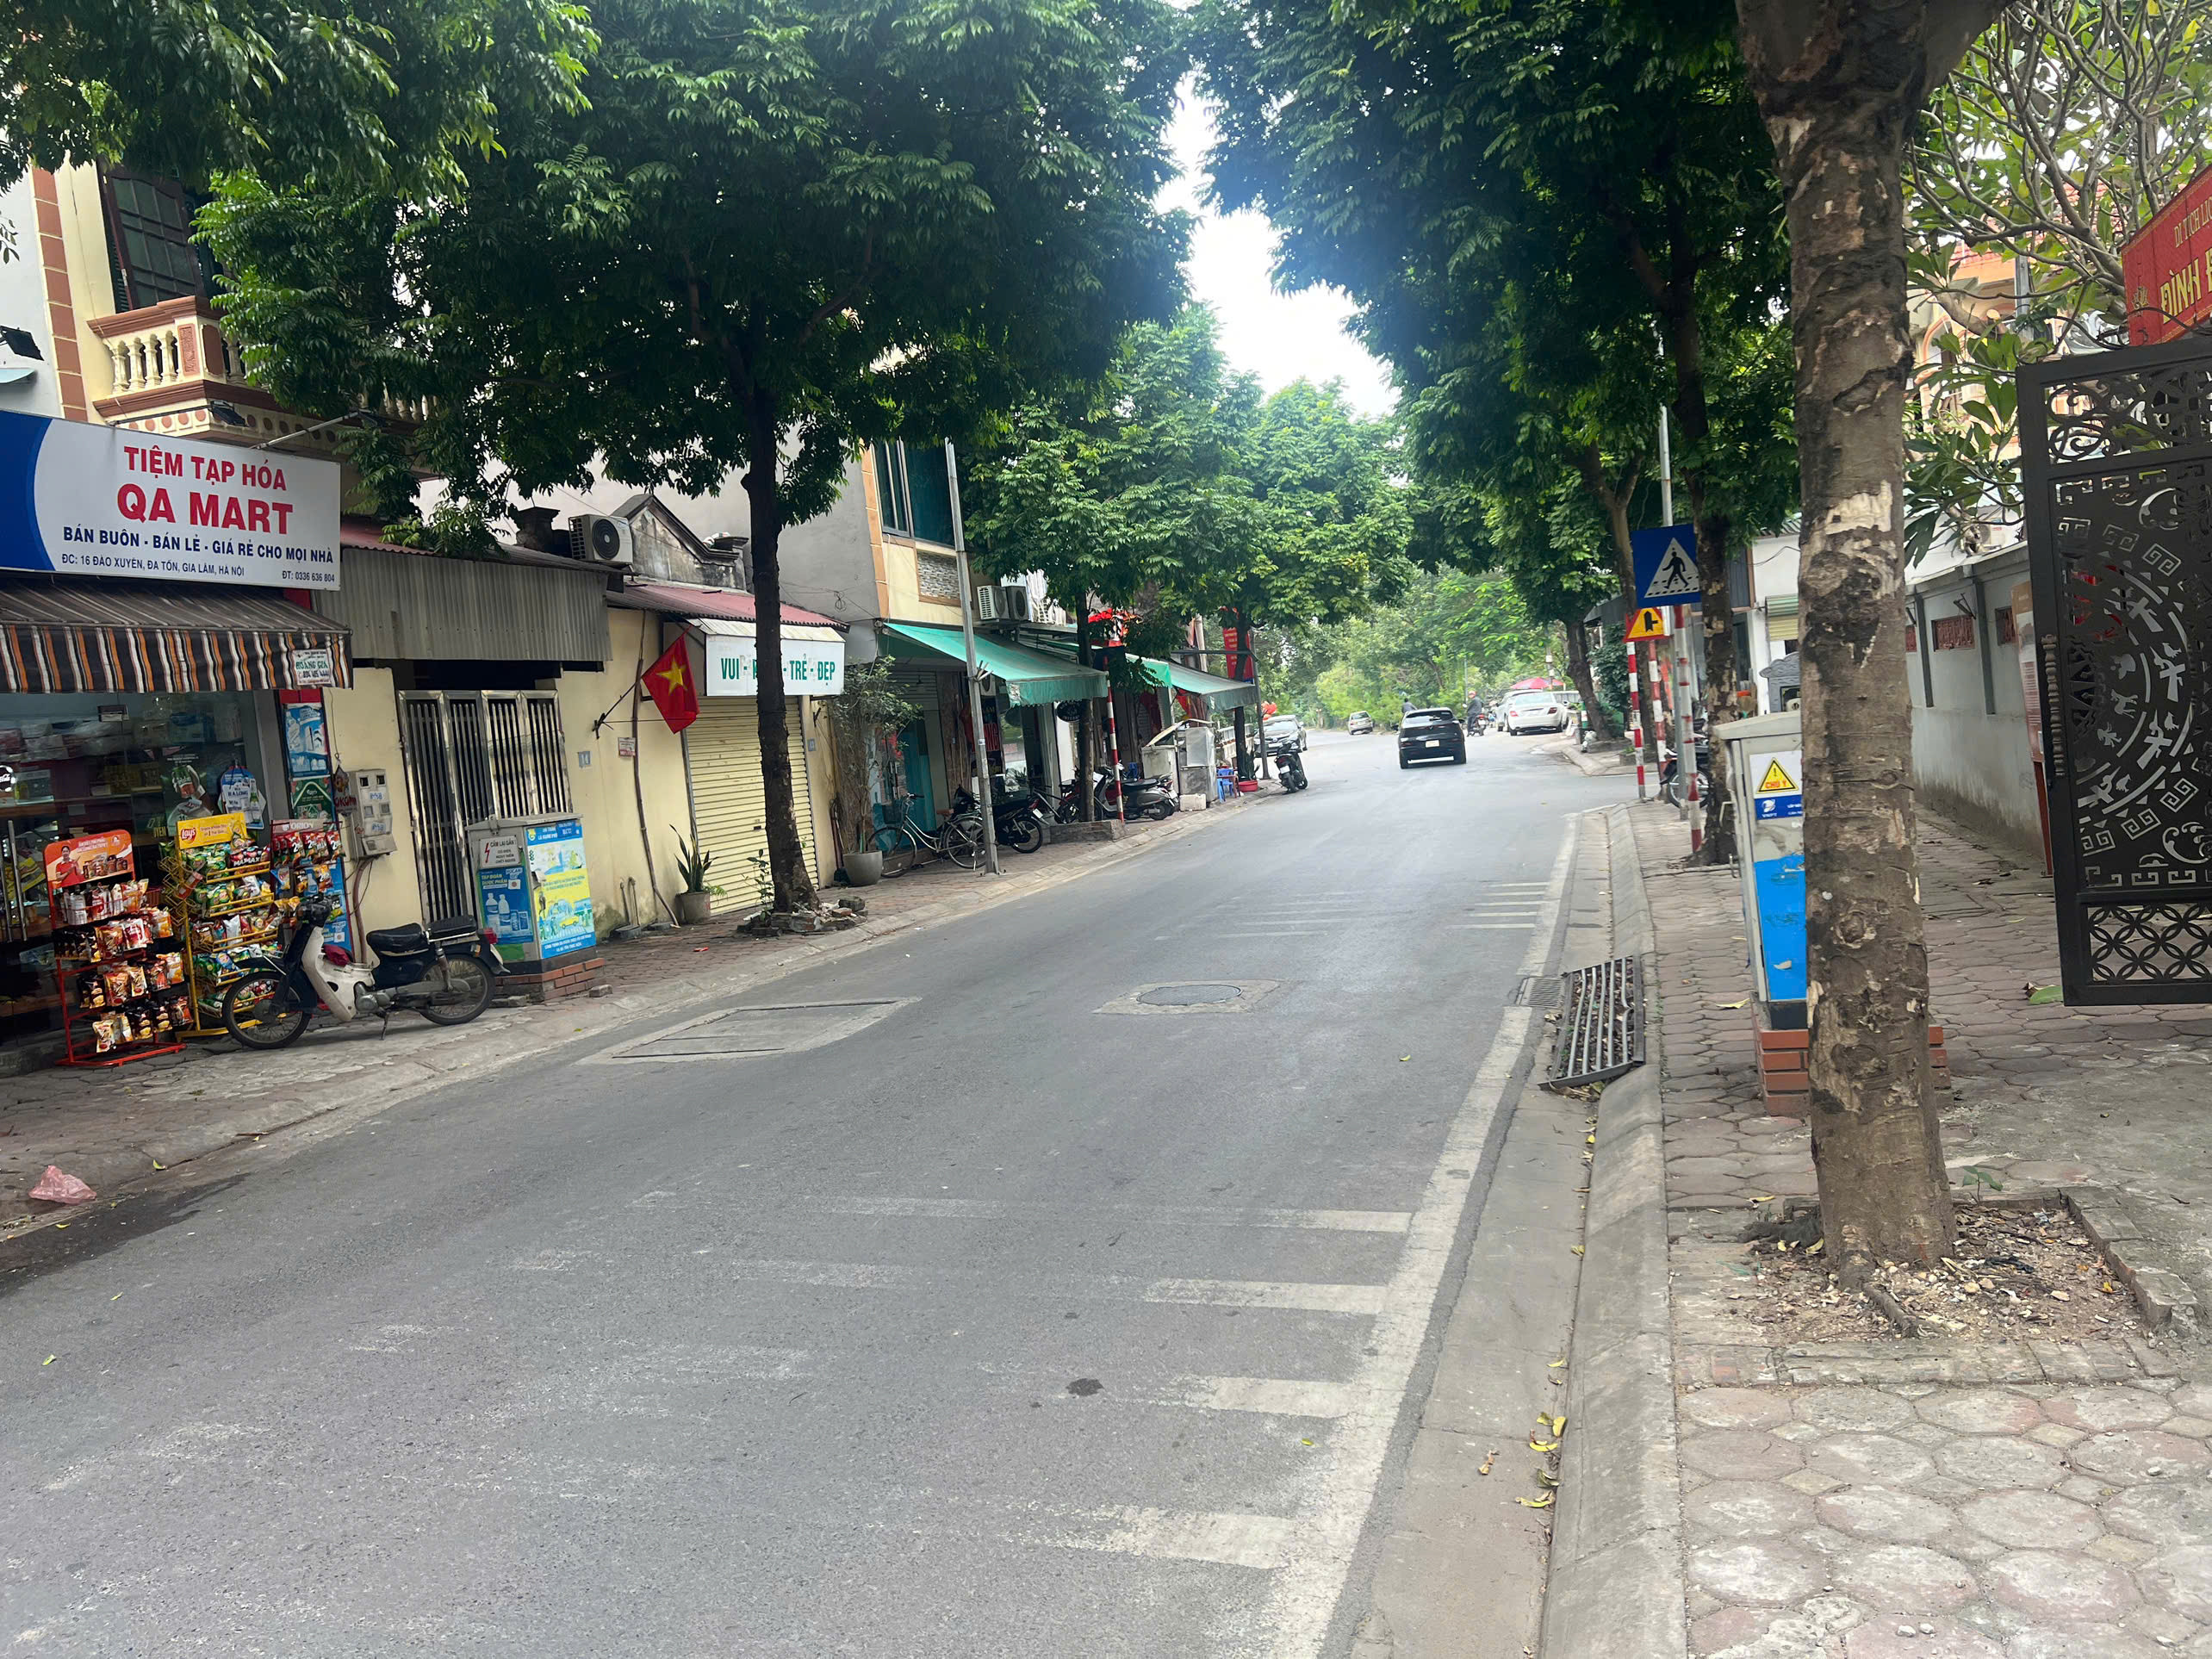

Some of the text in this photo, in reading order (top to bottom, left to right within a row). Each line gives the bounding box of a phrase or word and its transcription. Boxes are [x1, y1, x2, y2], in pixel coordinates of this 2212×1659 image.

[2159, 258, 2202, 325] ĐÌNH
[124, 444, 287, 491] TIỆM TẠP HÓA
[117, 483, 294, 535] QA MART
[63, 523, 94, 544] BÁN
[99, 528, 140, 547] BUÔN
[152, 531, 180, 550] BÁN
[185, 533, 201, 552] LẺ
[212, 537, 234, 556] GIÁ
[238, 539, 254, 556] RẺ
[258, 544, 283, 560] CHO
[286, 547, 307, 564] MỌI
[311, 547, 333, 563] NHÀ
[80, 555, 90, 565] 16
[147, 560, 159, 570] ĐA
[182, 562, 196, 573] GIA
[295, 571, 310, 581] 0336
[311, 572, 323, 582] 636
[720, 657, 740, 680] VUI
[789, 653, 808, 680] TRẺ
[817, 661, 836, 686] ĐẸP
